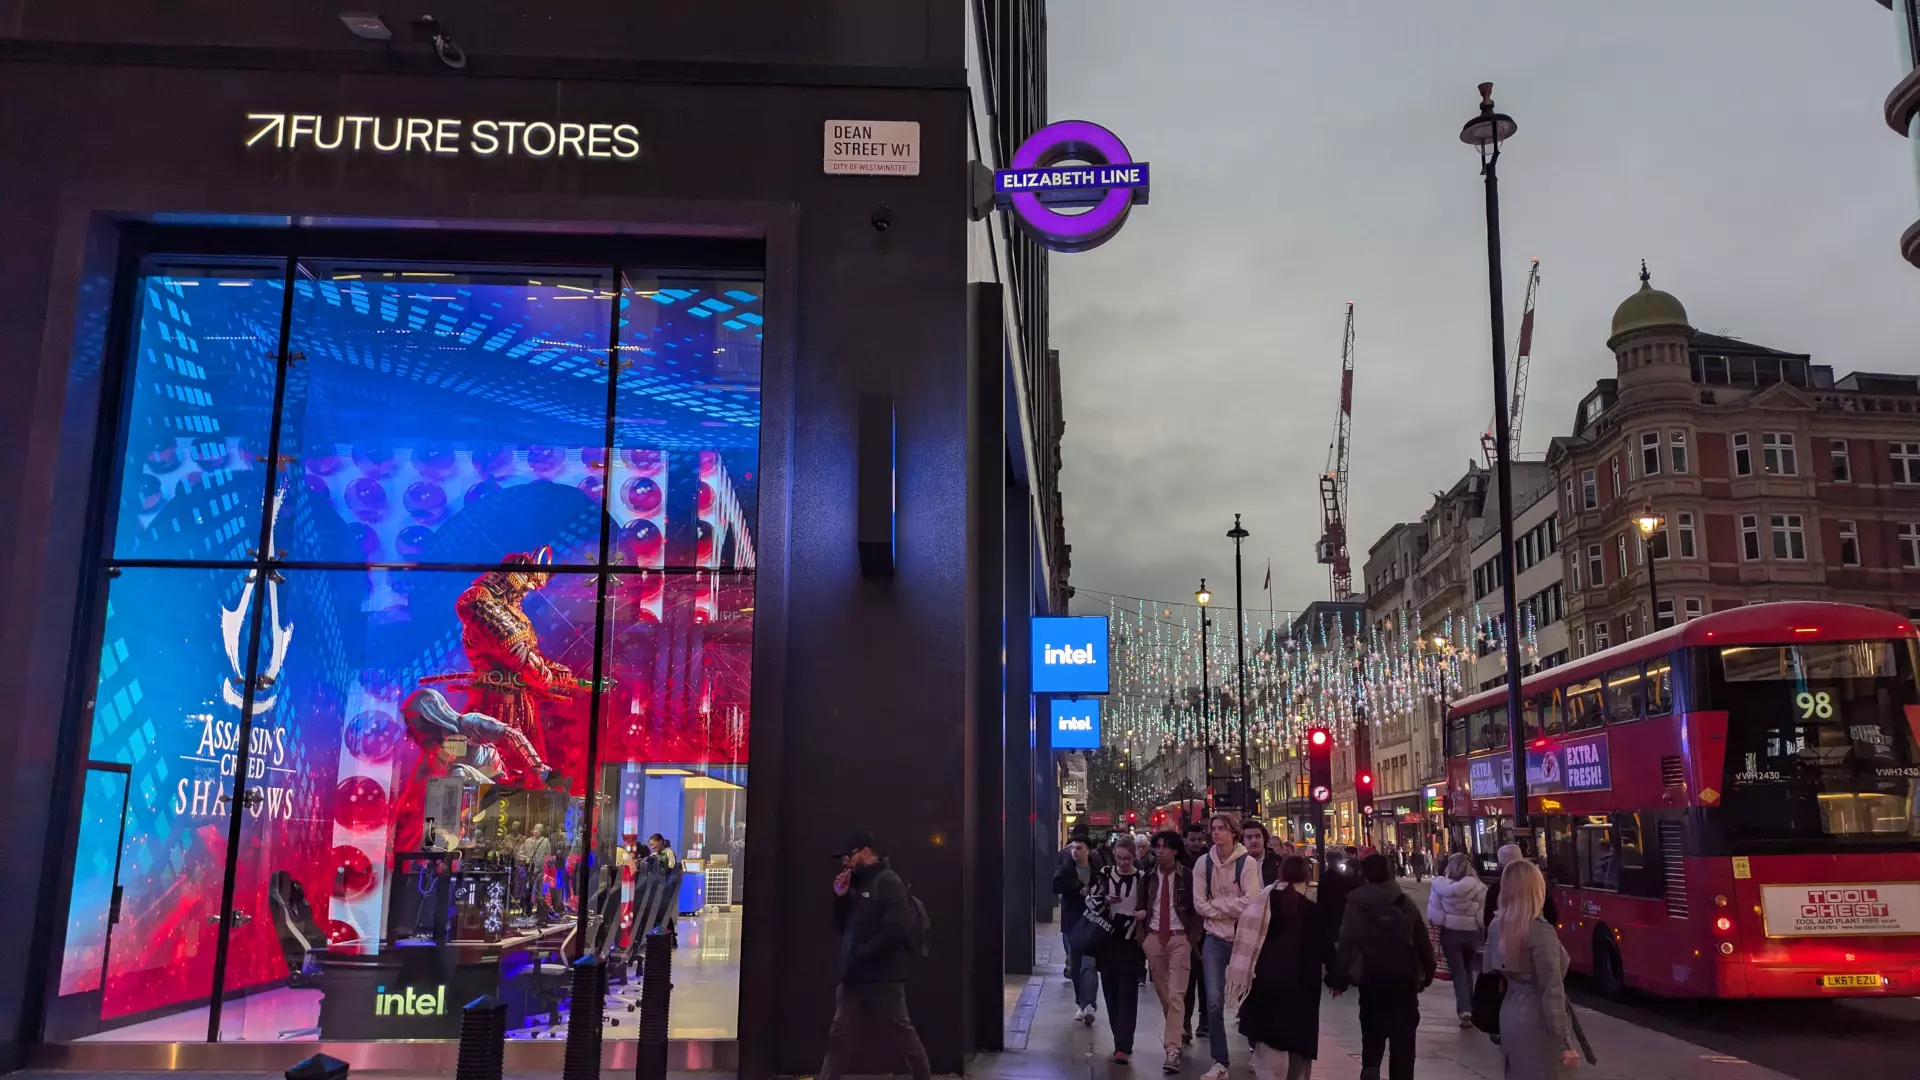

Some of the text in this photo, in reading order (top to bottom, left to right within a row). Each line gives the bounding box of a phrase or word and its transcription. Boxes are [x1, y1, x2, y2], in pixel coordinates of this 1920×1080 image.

[290, 114, 640, 159] FUTURE STORES
[834, 125, 872, 140] DEAN
[834, 141, 911, 157] STREET W1
[849, 163, 857, 171] OF
[859, 164, 907, 172] WESTMINSTER
[1003, 169, 1141, 188] ELIZABETH LINE
[1796, 692, 1832, 719] 98
[196, 717, 286, 766] ASSASIN'S
[1566, 743, 1599, 766] EXTRA
[220, 753, 265, 779] CRED
[1471, 762, 1493, 778] EXTRA
[1875, 768, 1919, 776] VWH2430
[1568, 765, 1602, 787] FRESH!
[1735, 771, 1780, 780] VWH2430
[175, 778, 295, 820] SHAOWS
[1808, 889, 1878, 903] TOOL
[1801, 903, 1889, 918] CHEST
[1828, 975, 1877, 986] LK67 EZU
